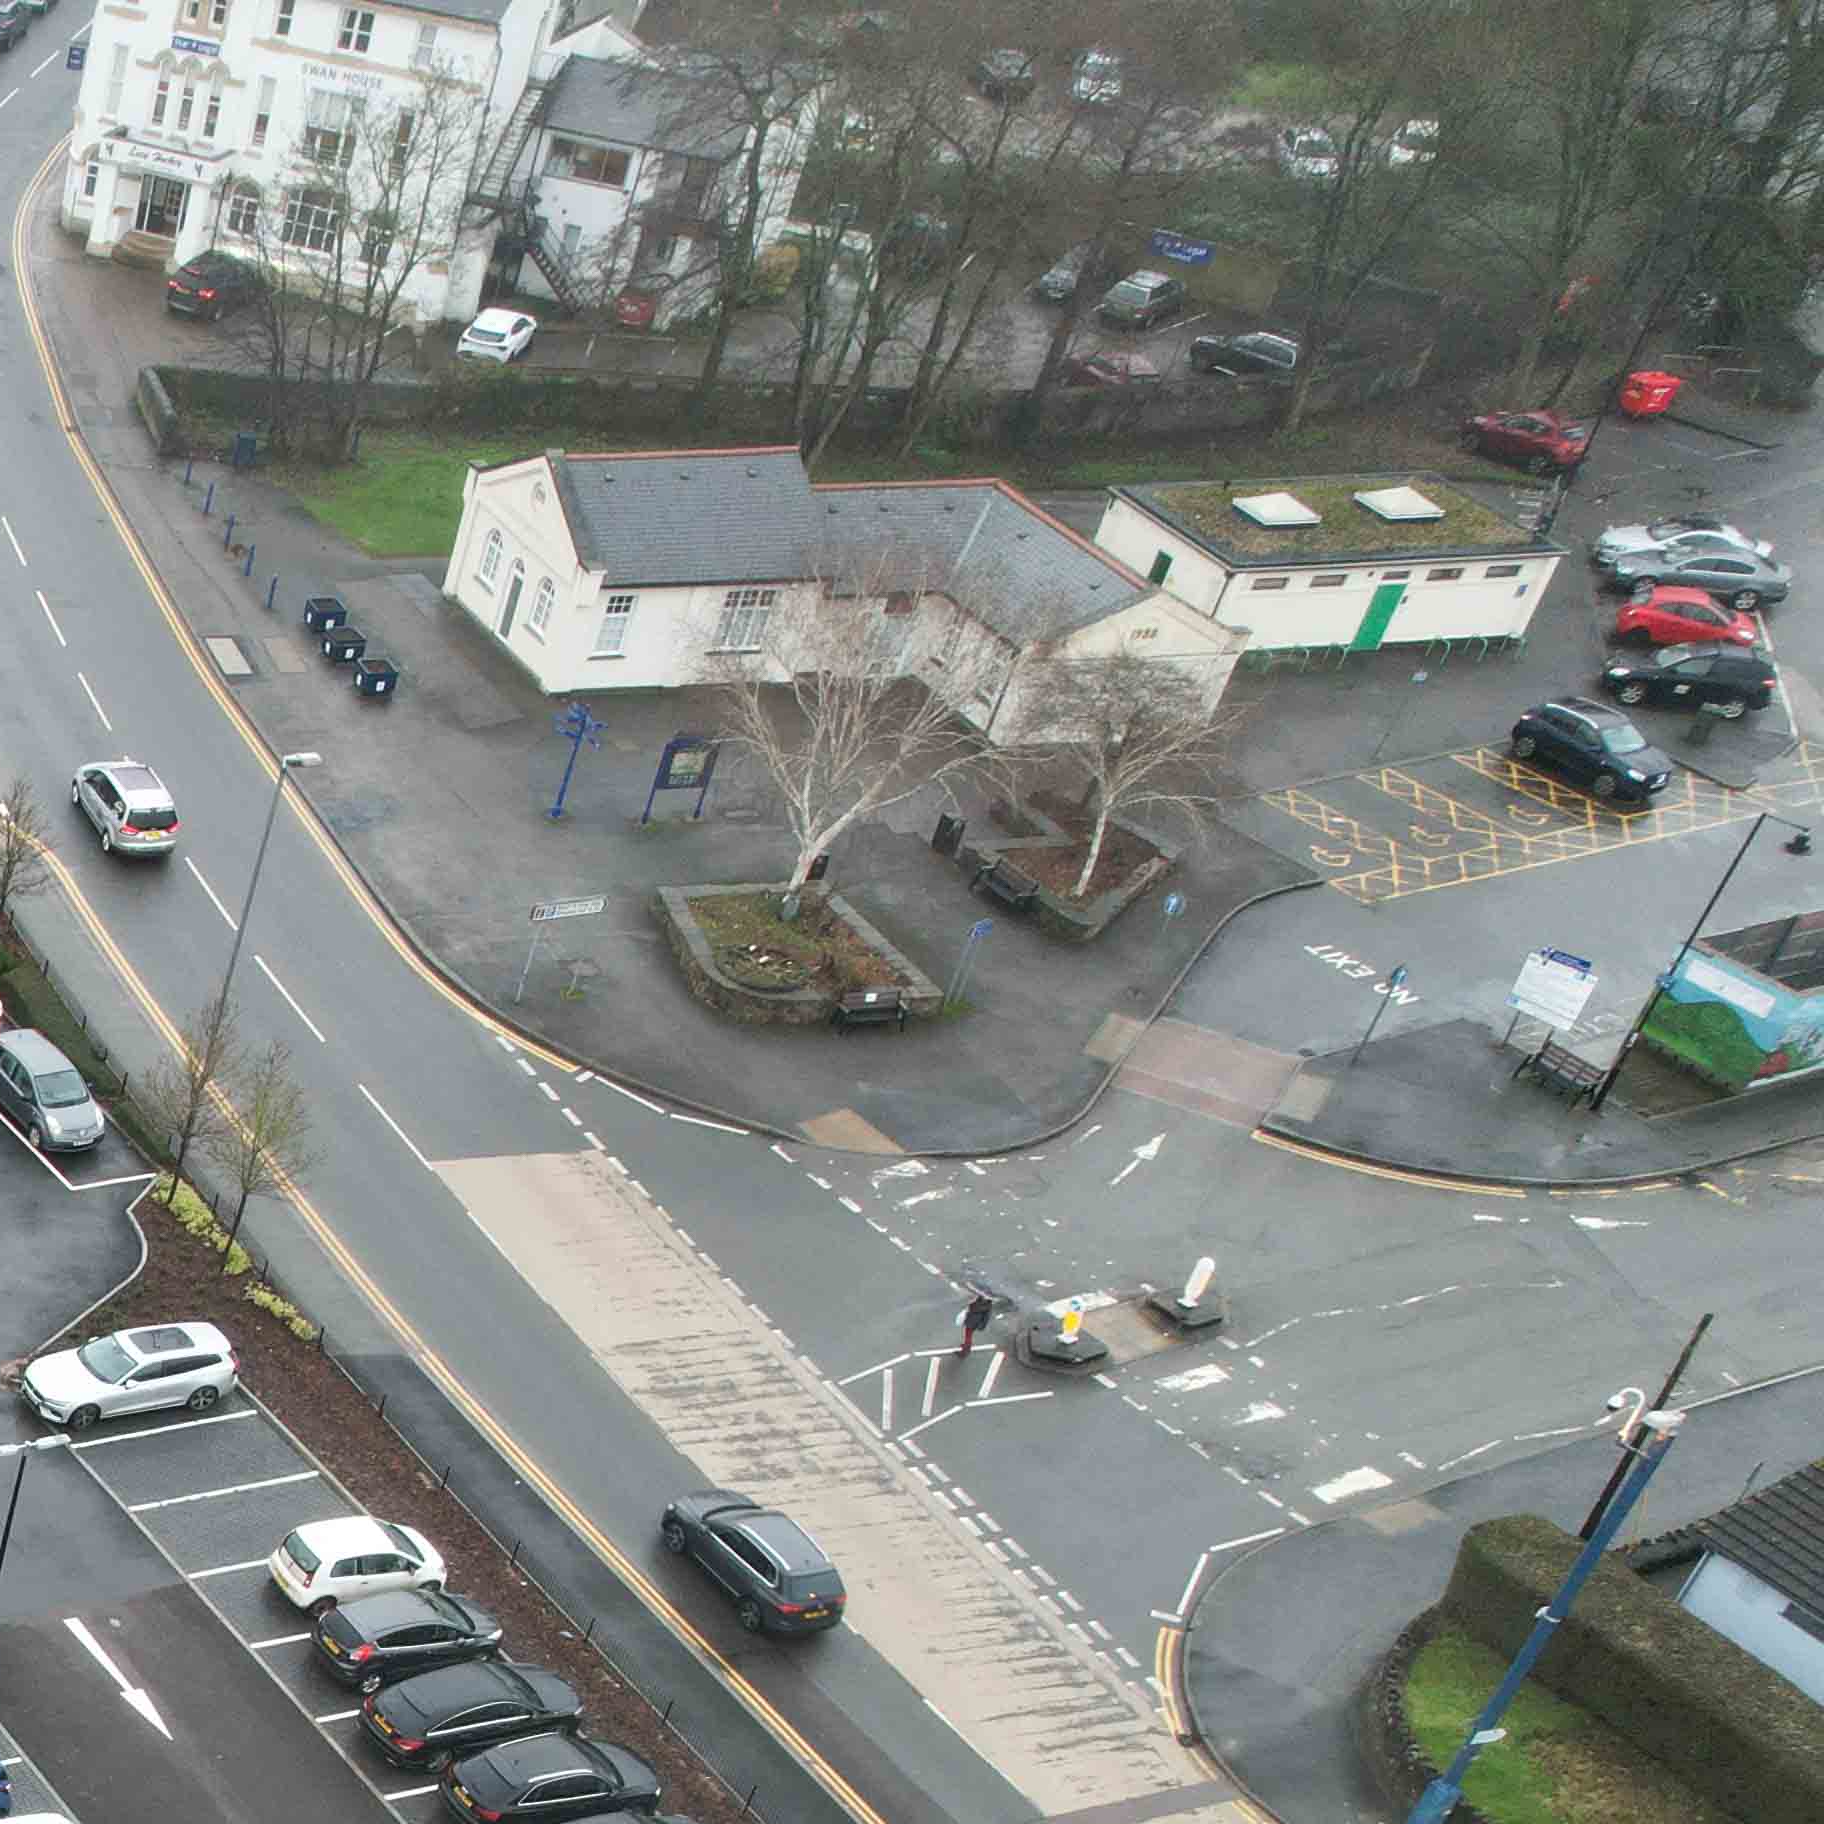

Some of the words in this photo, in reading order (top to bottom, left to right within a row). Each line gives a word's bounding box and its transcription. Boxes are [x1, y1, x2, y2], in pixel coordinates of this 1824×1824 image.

[302, 64, 336, 81] SWAN
[343, 72, 383, 89] HOUSE
[1304, 944, 1377, 978] EXIT
